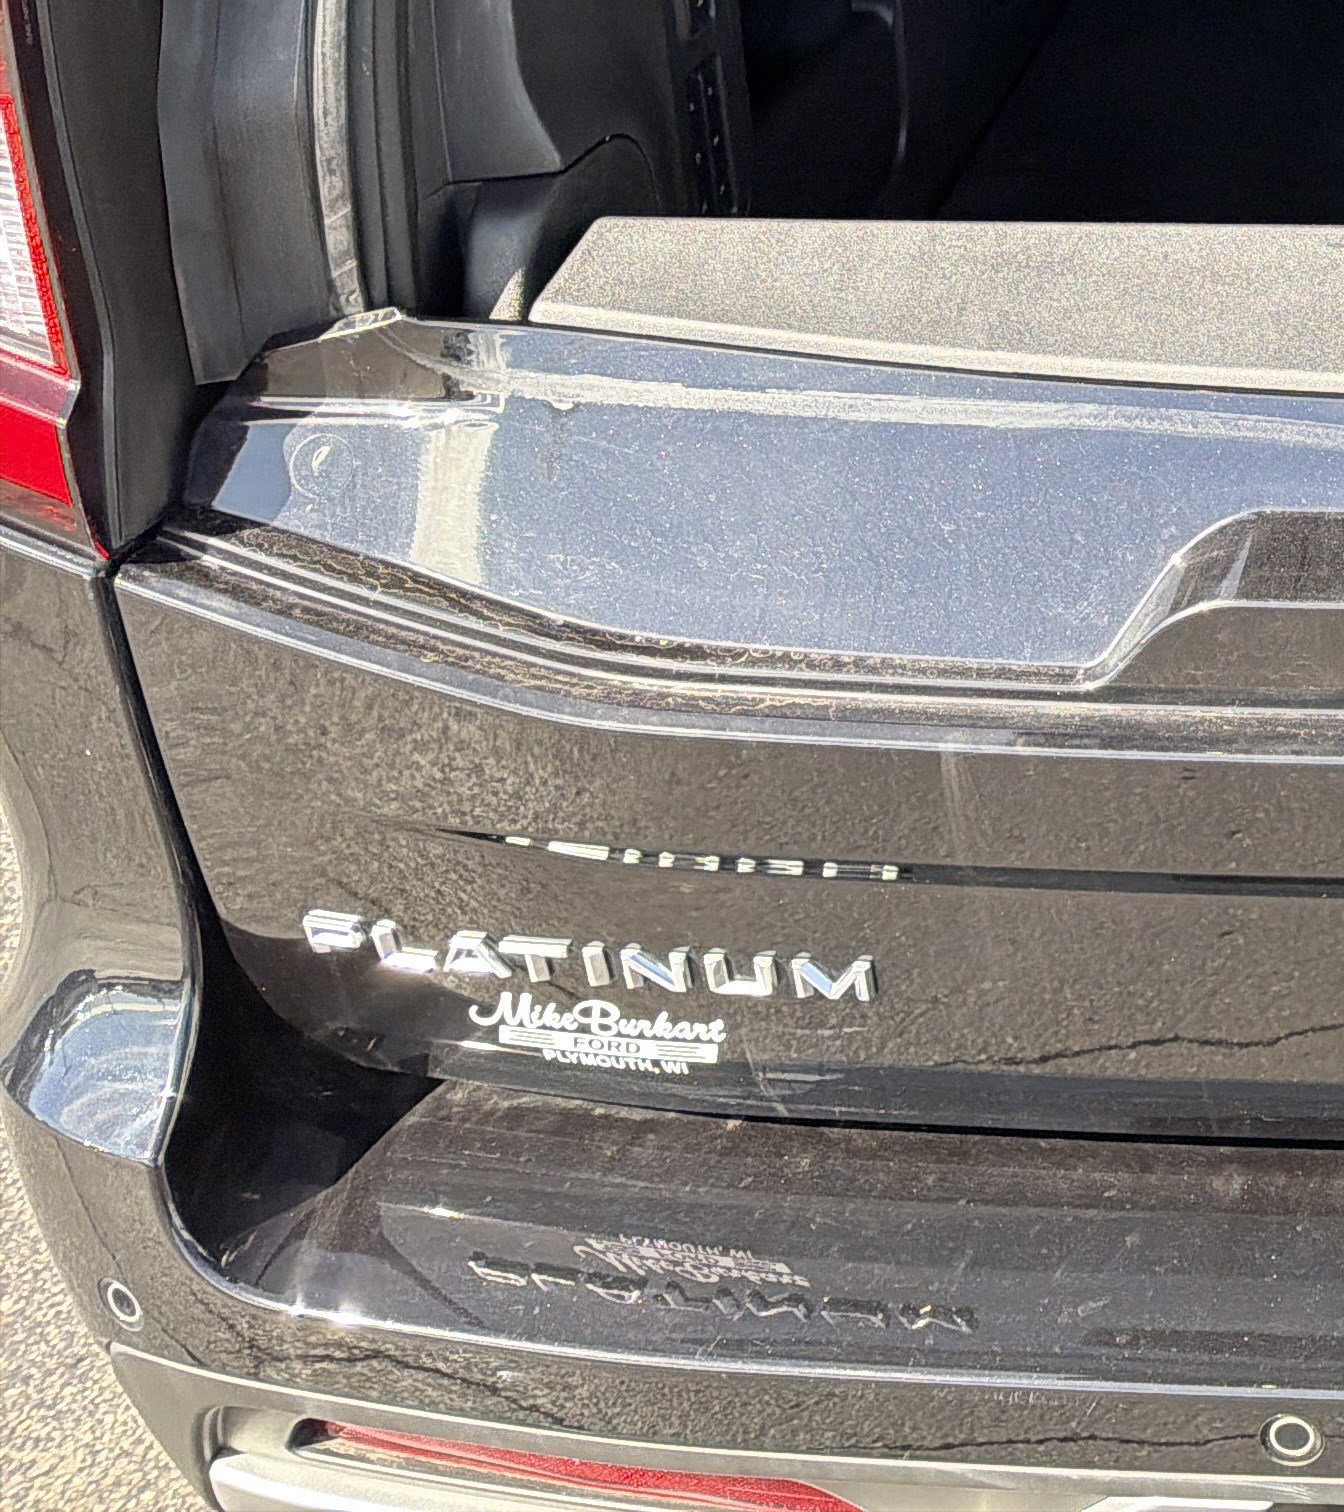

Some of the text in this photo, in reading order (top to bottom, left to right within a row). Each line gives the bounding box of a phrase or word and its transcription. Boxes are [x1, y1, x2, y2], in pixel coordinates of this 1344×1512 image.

[302, 909, 876, 1002] PLATINUM
[468, 991, 727, 1042] Mike Burkart
[542, 1048, 689, 1075] PLYMOUTH, WI
[573, 1036, 641, 1054] FORD
